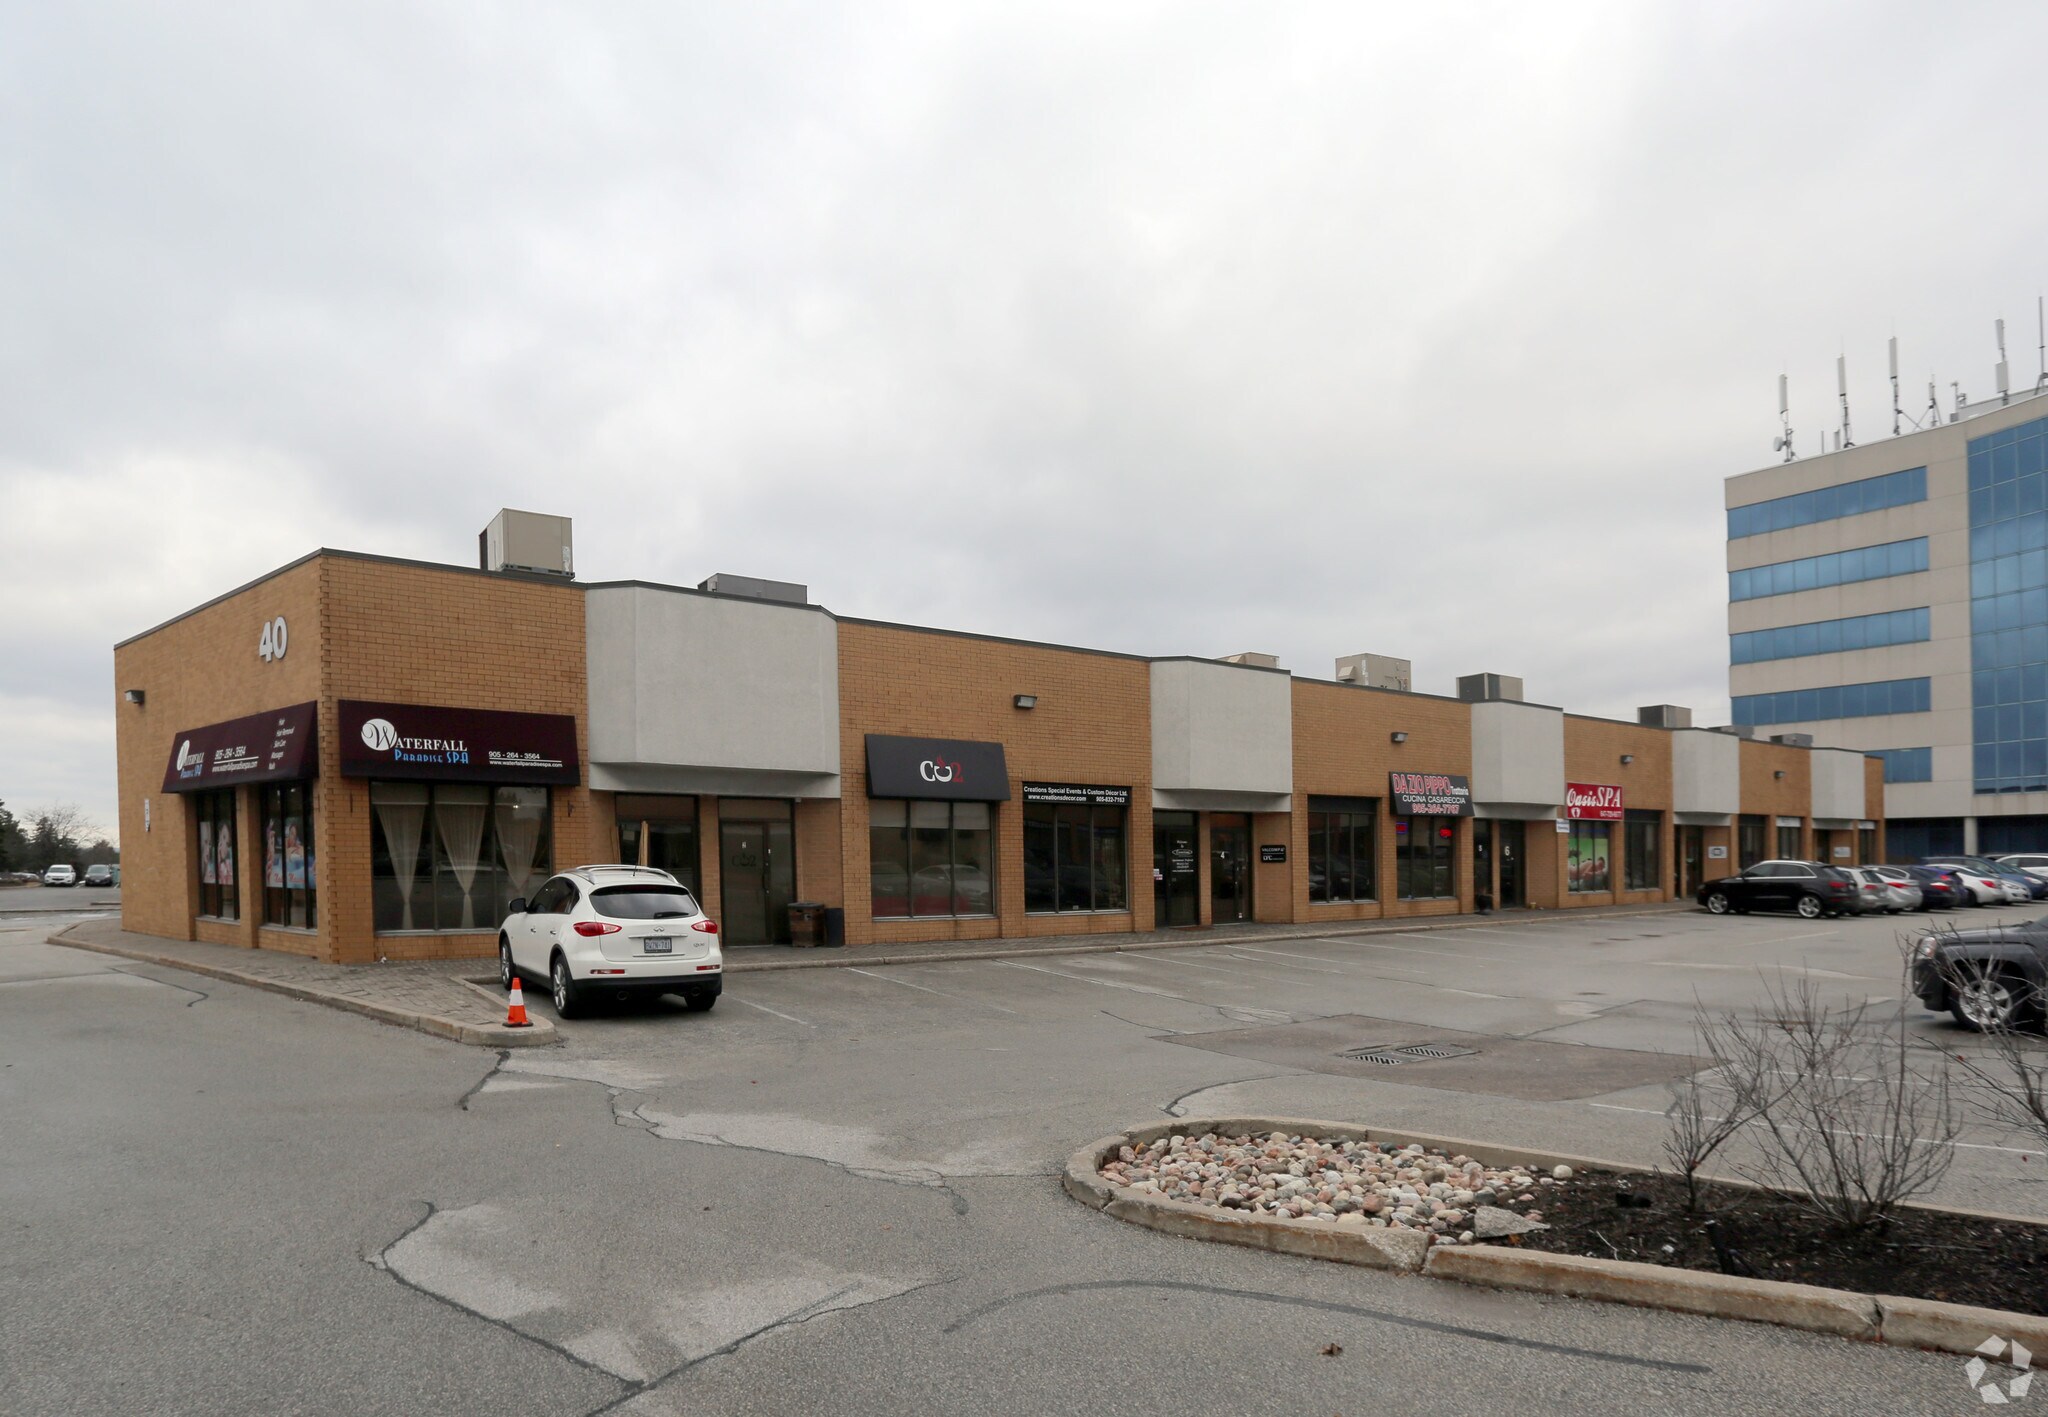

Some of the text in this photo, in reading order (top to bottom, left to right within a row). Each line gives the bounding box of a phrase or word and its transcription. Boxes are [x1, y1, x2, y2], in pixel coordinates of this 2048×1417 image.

[259, 616, 288, 662] 40
[361, 720, 468, 752] WATERFALL
[446, 751, 469, 764] SPA
[1392, 773, 1408, 794] DA
[1407, 774, 1425, 794] ZIO
[1424, 775, 1452, 796] PIPPO
[1048, 787, 1065, 795] Special
[1028, 794, 1087, 802] www.creationsdecor.com
[1402, 794, 1466, 804] CUCINA CASARECCIA
[1567, 787, 1621, 808] Oasis SPA
[1220, 851, 1225, 859] 4
[1504, 845, 1510, 856] 6
